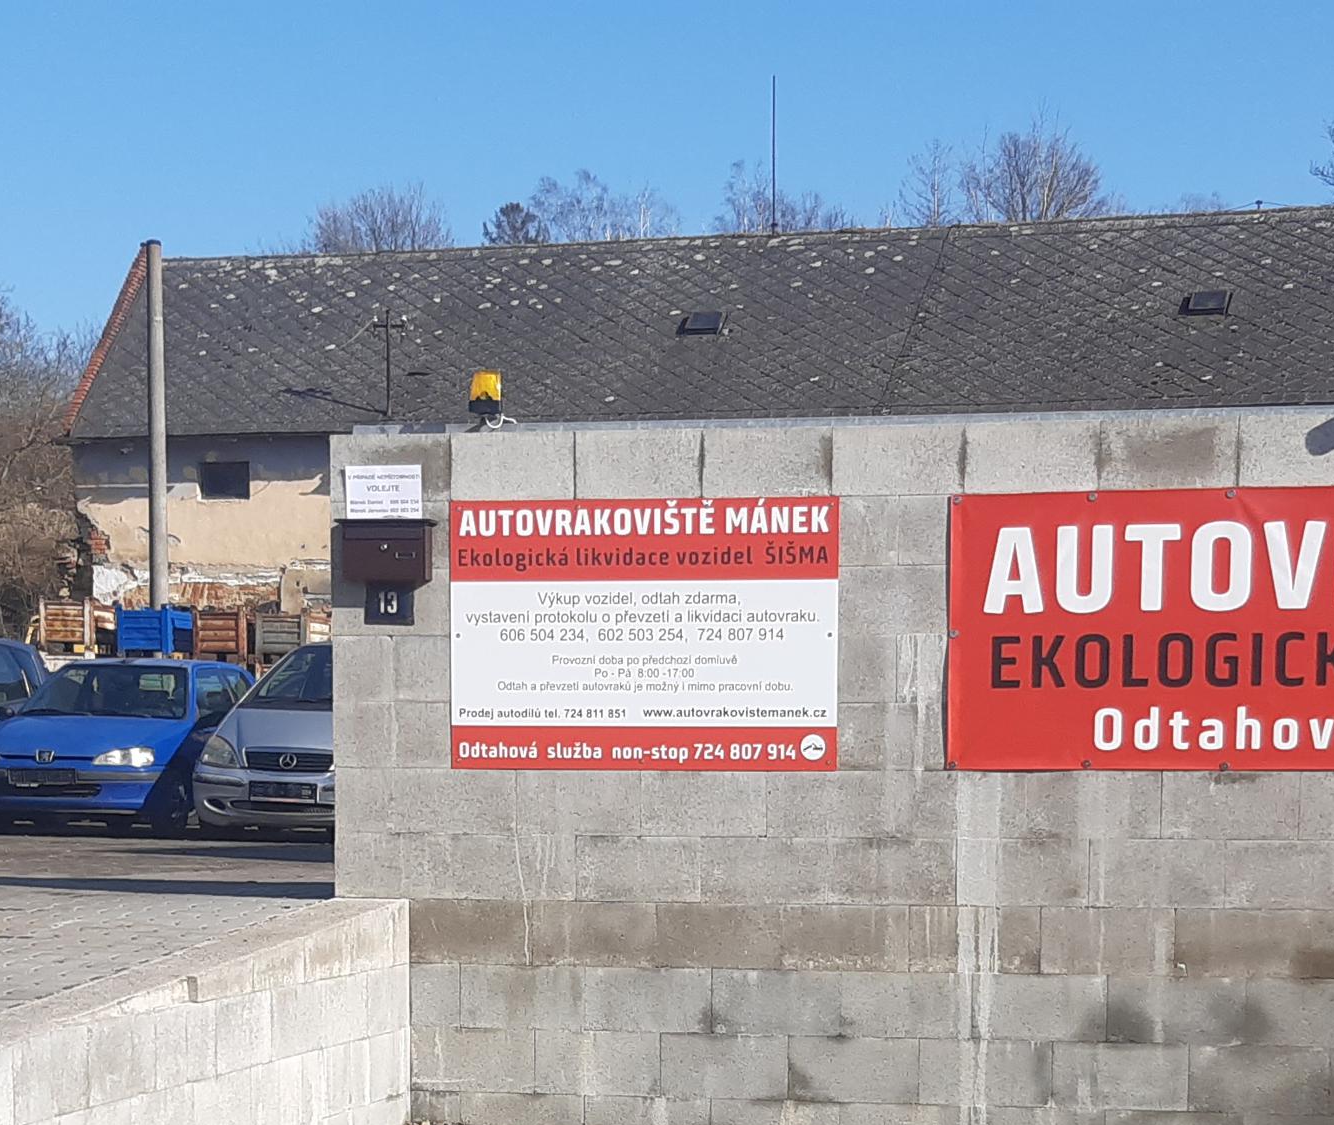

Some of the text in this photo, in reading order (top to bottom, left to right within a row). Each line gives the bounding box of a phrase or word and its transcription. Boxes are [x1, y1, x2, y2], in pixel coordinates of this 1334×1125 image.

[366, 484, 400, 492] VOLEJTE
[459, 498, 829, 537] AUTOVRAKOVIŠTĚ MÁNEK
[458, 541, 828, 572] Ekologická likvidace vozidel ŠIŠMA
[378, 591, 398, 614] 13
[537, 591, 741, 608] Výkup vozidel, odtah zdarma,
[466, 609, 820, 626] vystavení protokolu o převzetí a likvidaci autovraku.
[499, 628, 784, 643] 606 504 234, 602 503 254, 724 807 914
[551, 655, 596, 665] Provozní
[598, 655, 624, 665] doba
[626, 657, 639, 667] po
[642, 655, 691, 667] předchozí
[594, 668, 608, 678] Po
[637, 668, 660, 678] 8:00
[497, 681, 528, 691] Odtah
[530, 682, 537, 691] a
[539, 680, 579, 693] převzetí
[582, 680, 631, 691] autovraků
[633, 681, 643, 693] je
[645, 680, 678, 693] možný
[687, 681, 715, 691] mimo
[718, 680, 762, 693] pracovní
[764, 680, 794, 691] dobu.
[459, 706, 828, 720] Prodej autodílů tel. 724 811 851 www.autovrakovistemanek.cz
[459, 741, 796, 764] Odtahová služba non-stop 724 807 914
